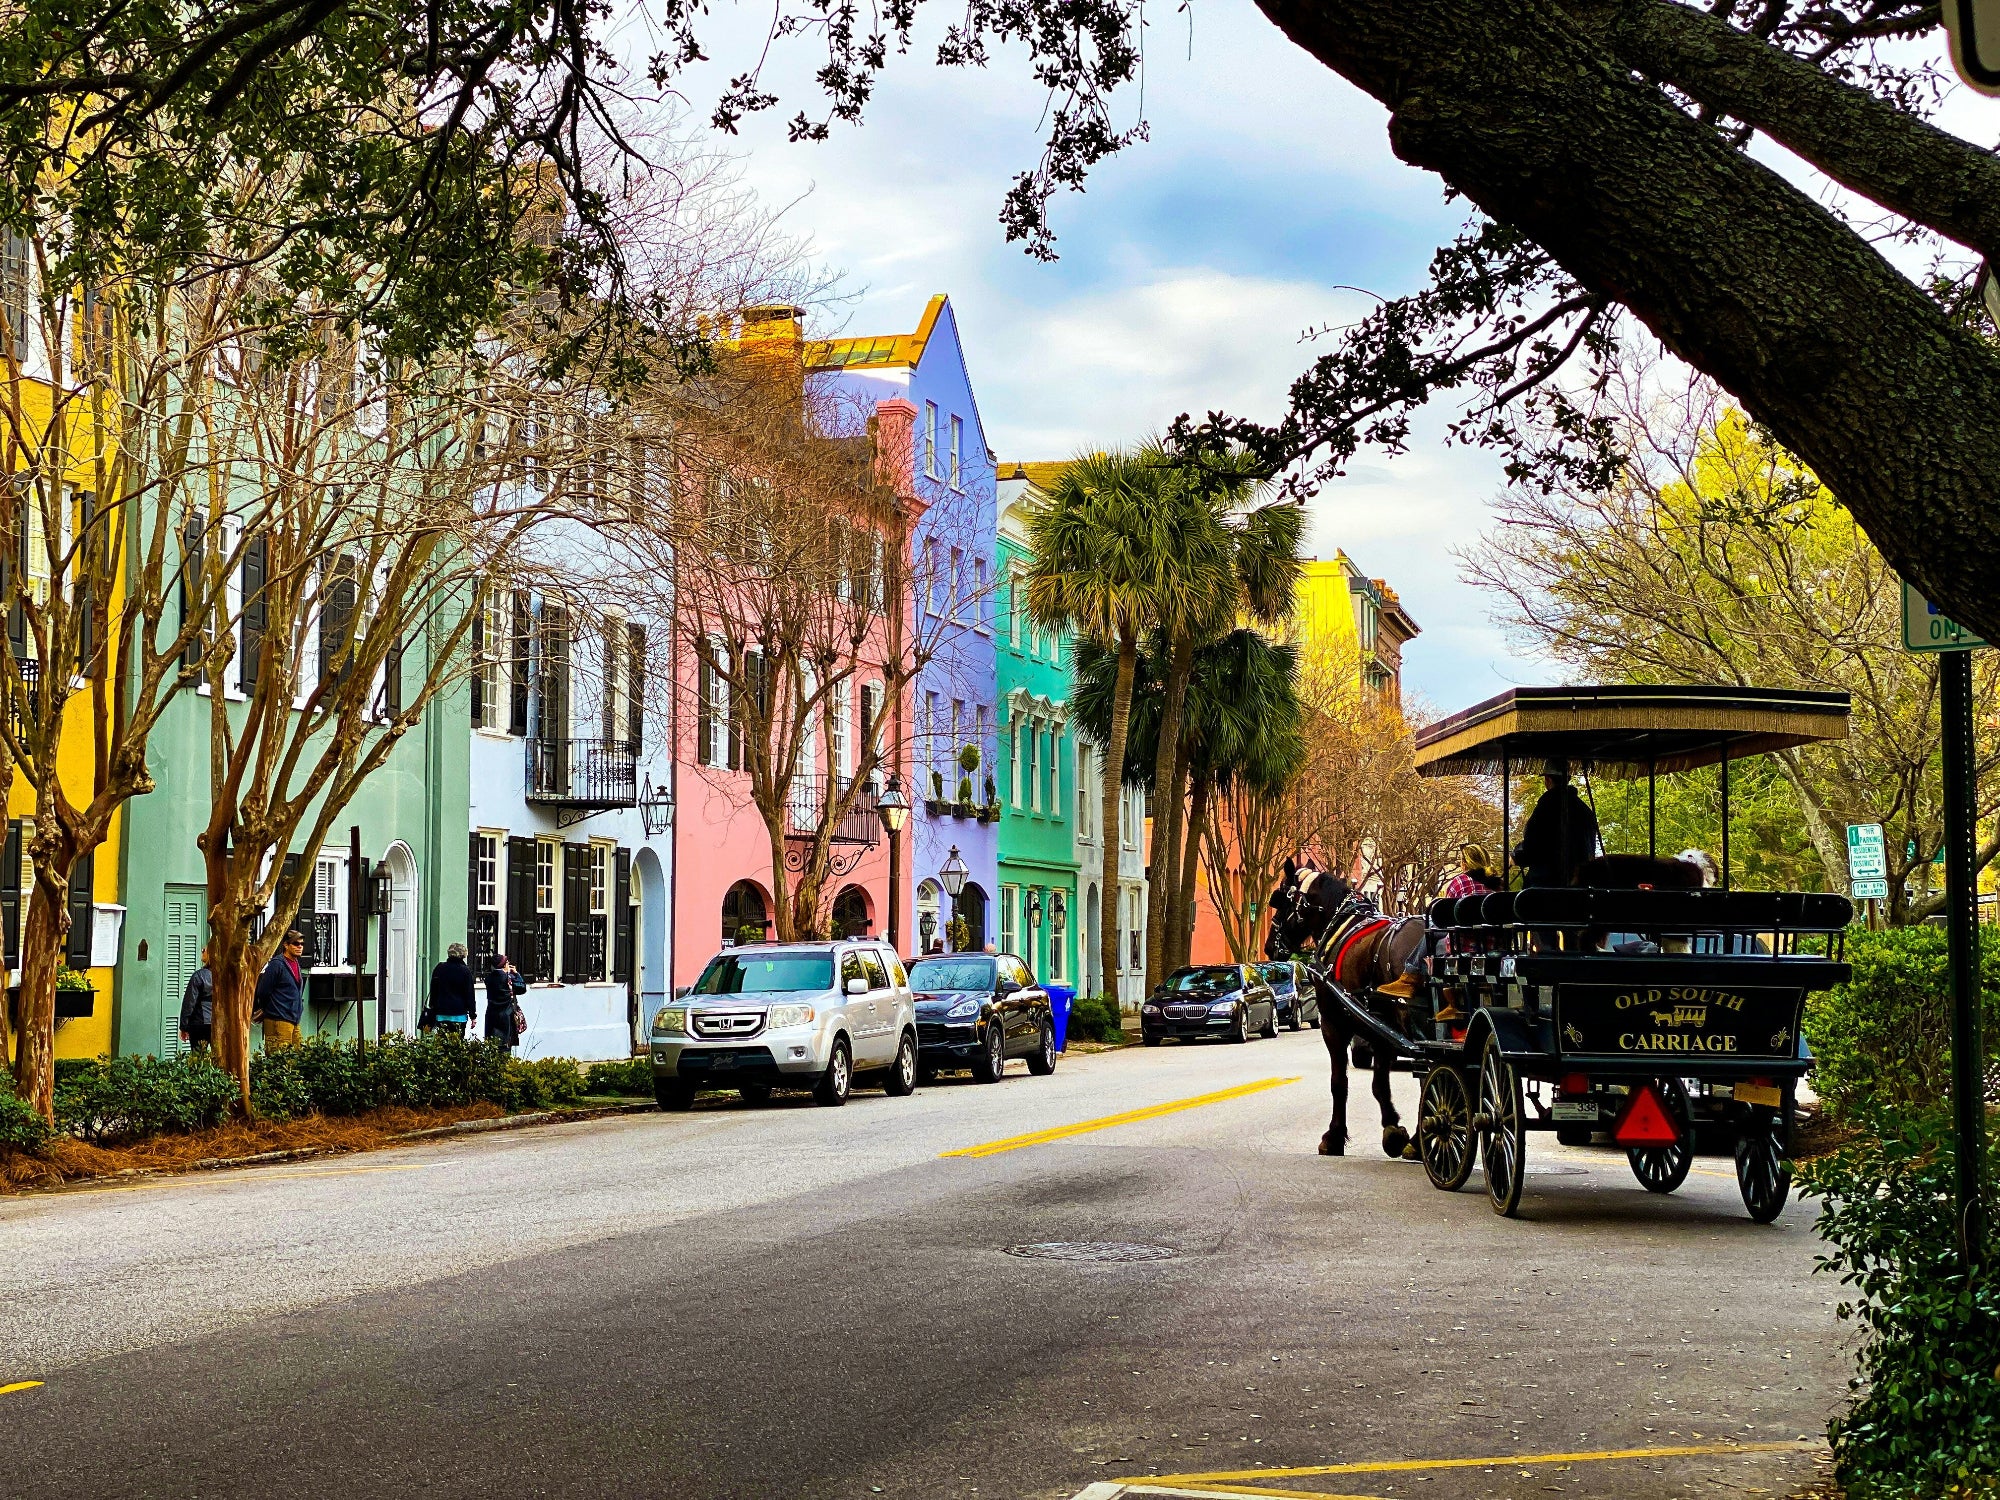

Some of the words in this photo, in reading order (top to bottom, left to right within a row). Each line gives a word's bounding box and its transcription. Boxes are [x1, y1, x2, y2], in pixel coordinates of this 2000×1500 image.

[1930, 619, 1976, 639] ONL
[1859, 836, 1881, 844] PARKING
[1853, 846, 1879, 854] RESIDENTIAL
[1615, 989, 1662, 1009] OLD
[1669, 988, 1745, 1011] SOUTH
[1619, 1033, 1737, 1052] CARRIAGE
[1577, 1103, 1597, 1112] 338
